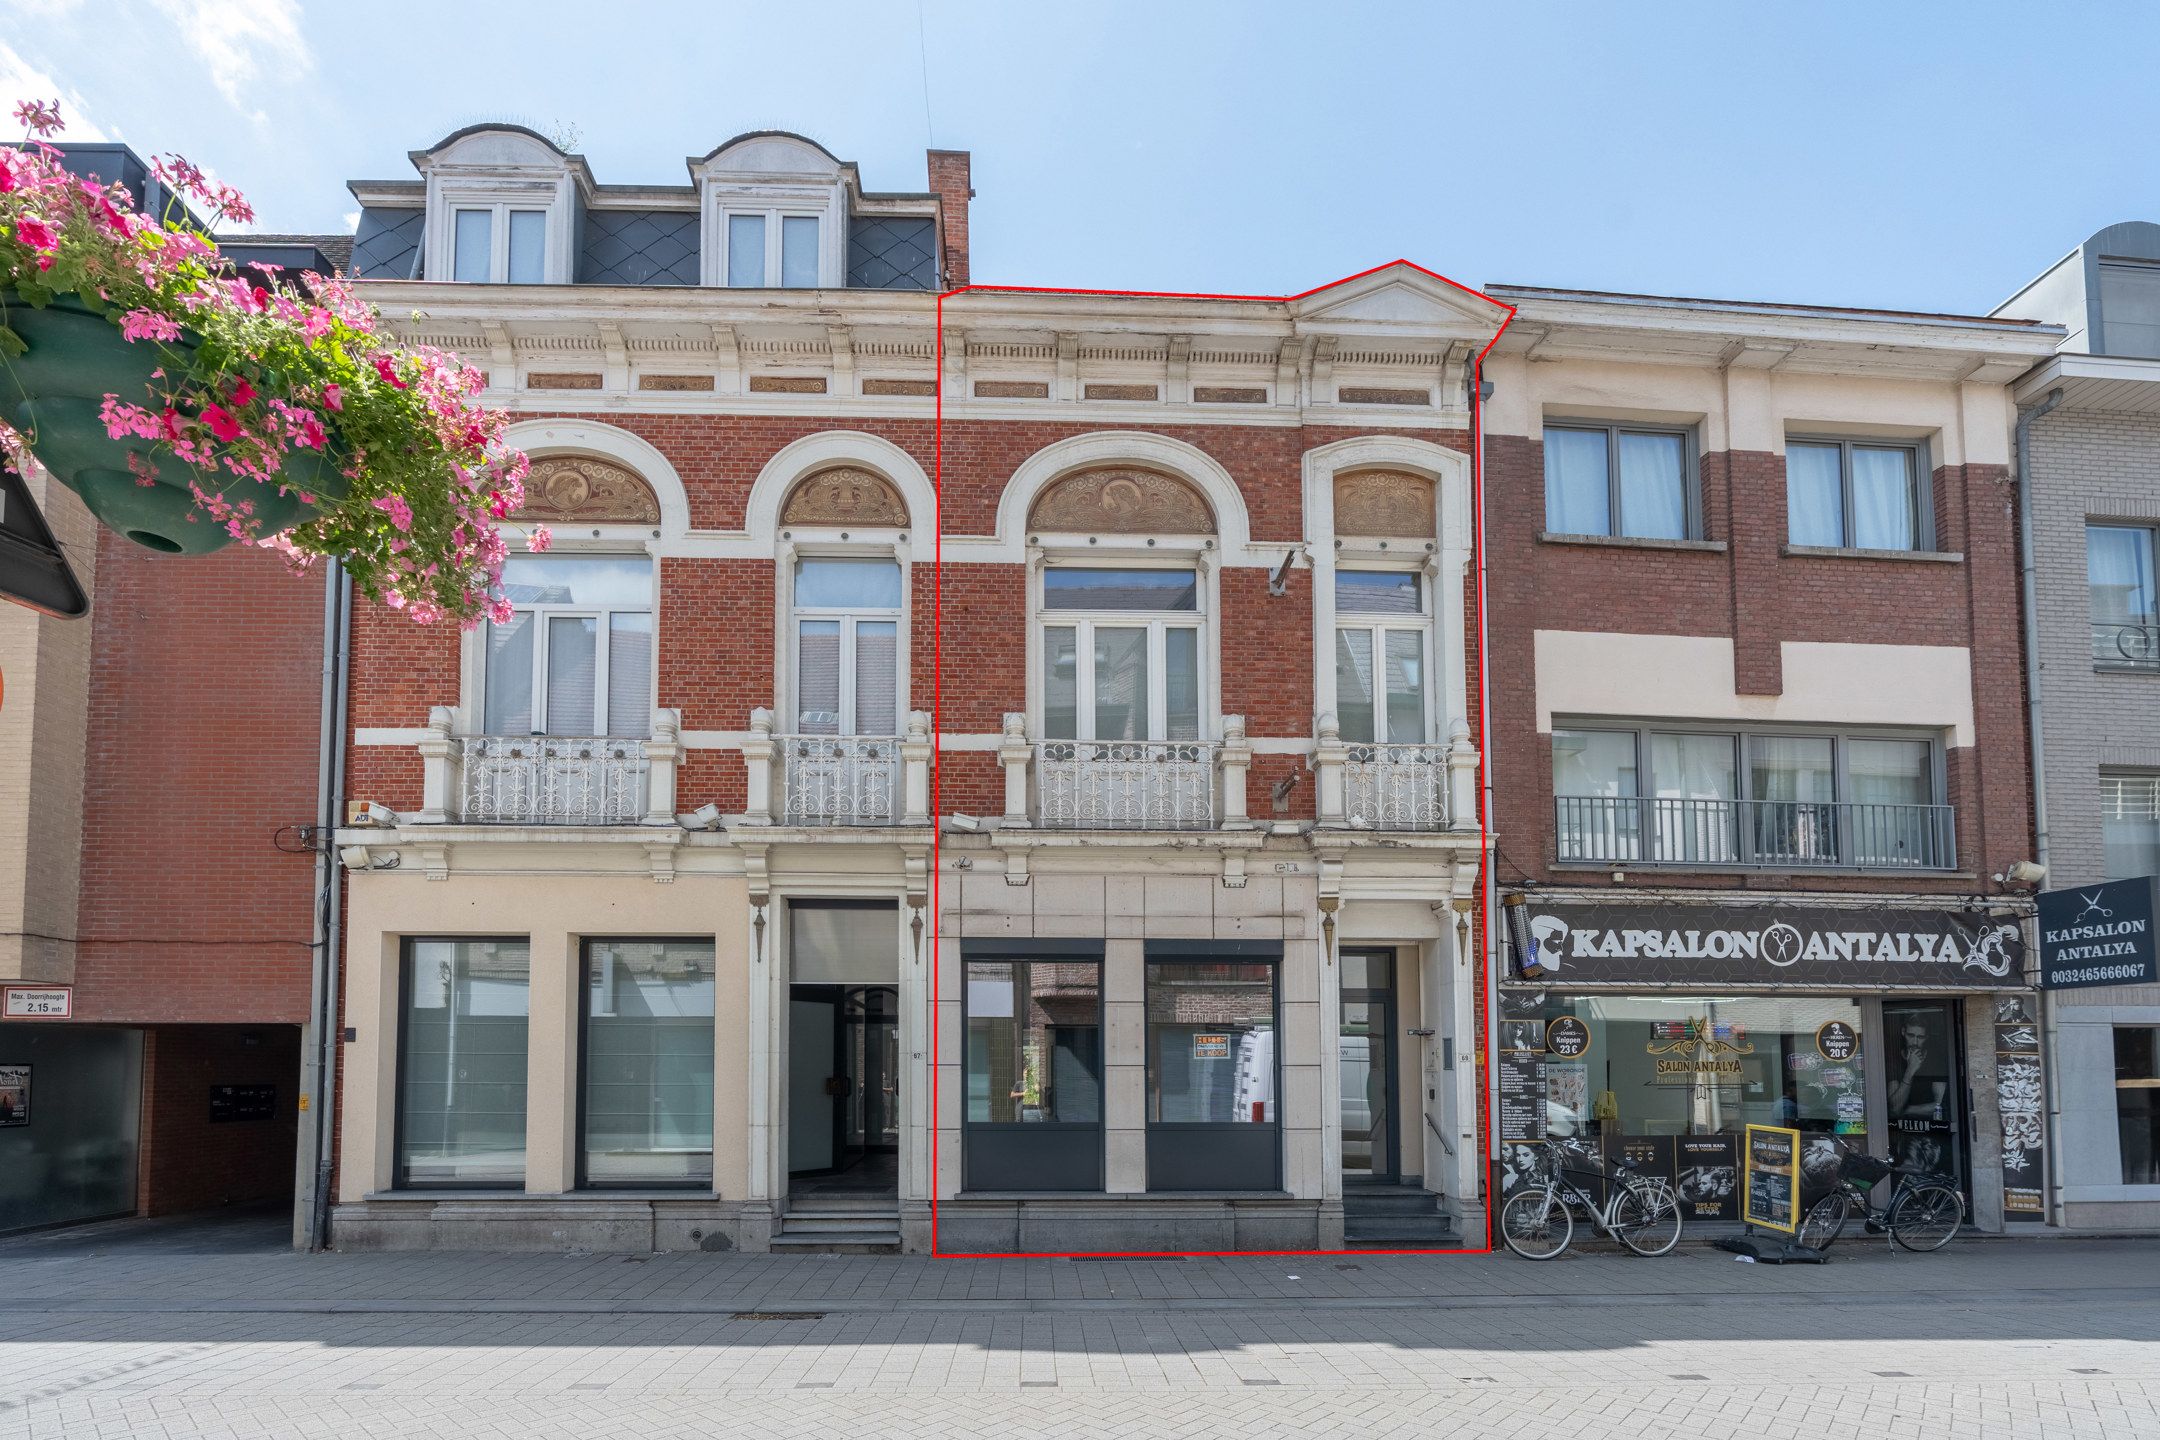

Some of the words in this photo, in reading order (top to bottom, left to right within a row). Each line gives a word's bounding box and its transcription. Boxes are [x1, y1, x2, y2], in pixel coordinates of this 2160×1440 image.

[2046, 919, 2146, 943] KAPSALON
[1571, 929, 1760, 958] KAPSALON
[1802, 931, 1963, 963] ANTALYA
[2056, 941, 2137, 961] ANTALYA
[2051, 963, 2145, 983] 0032465666067
[26, 993, 65, 1001] Doorrijhoogte
[27, 1003, 49, 1012] 2.15
[1556, 1036, 1581, 1044] Knippen
[1560, 1045, 1571, 1054] 23
[1571, 1045, 1578, 1054] €
[1830, 1049, 1841, 1057] 20
[1842, 1049, 1848, 1057] €
[1657, 1059, 1691, 1074] SALON
[1693, 1059, 1743, 1073] ANTALYA
[1898, 1120, 1930, 1131] WELKOM
